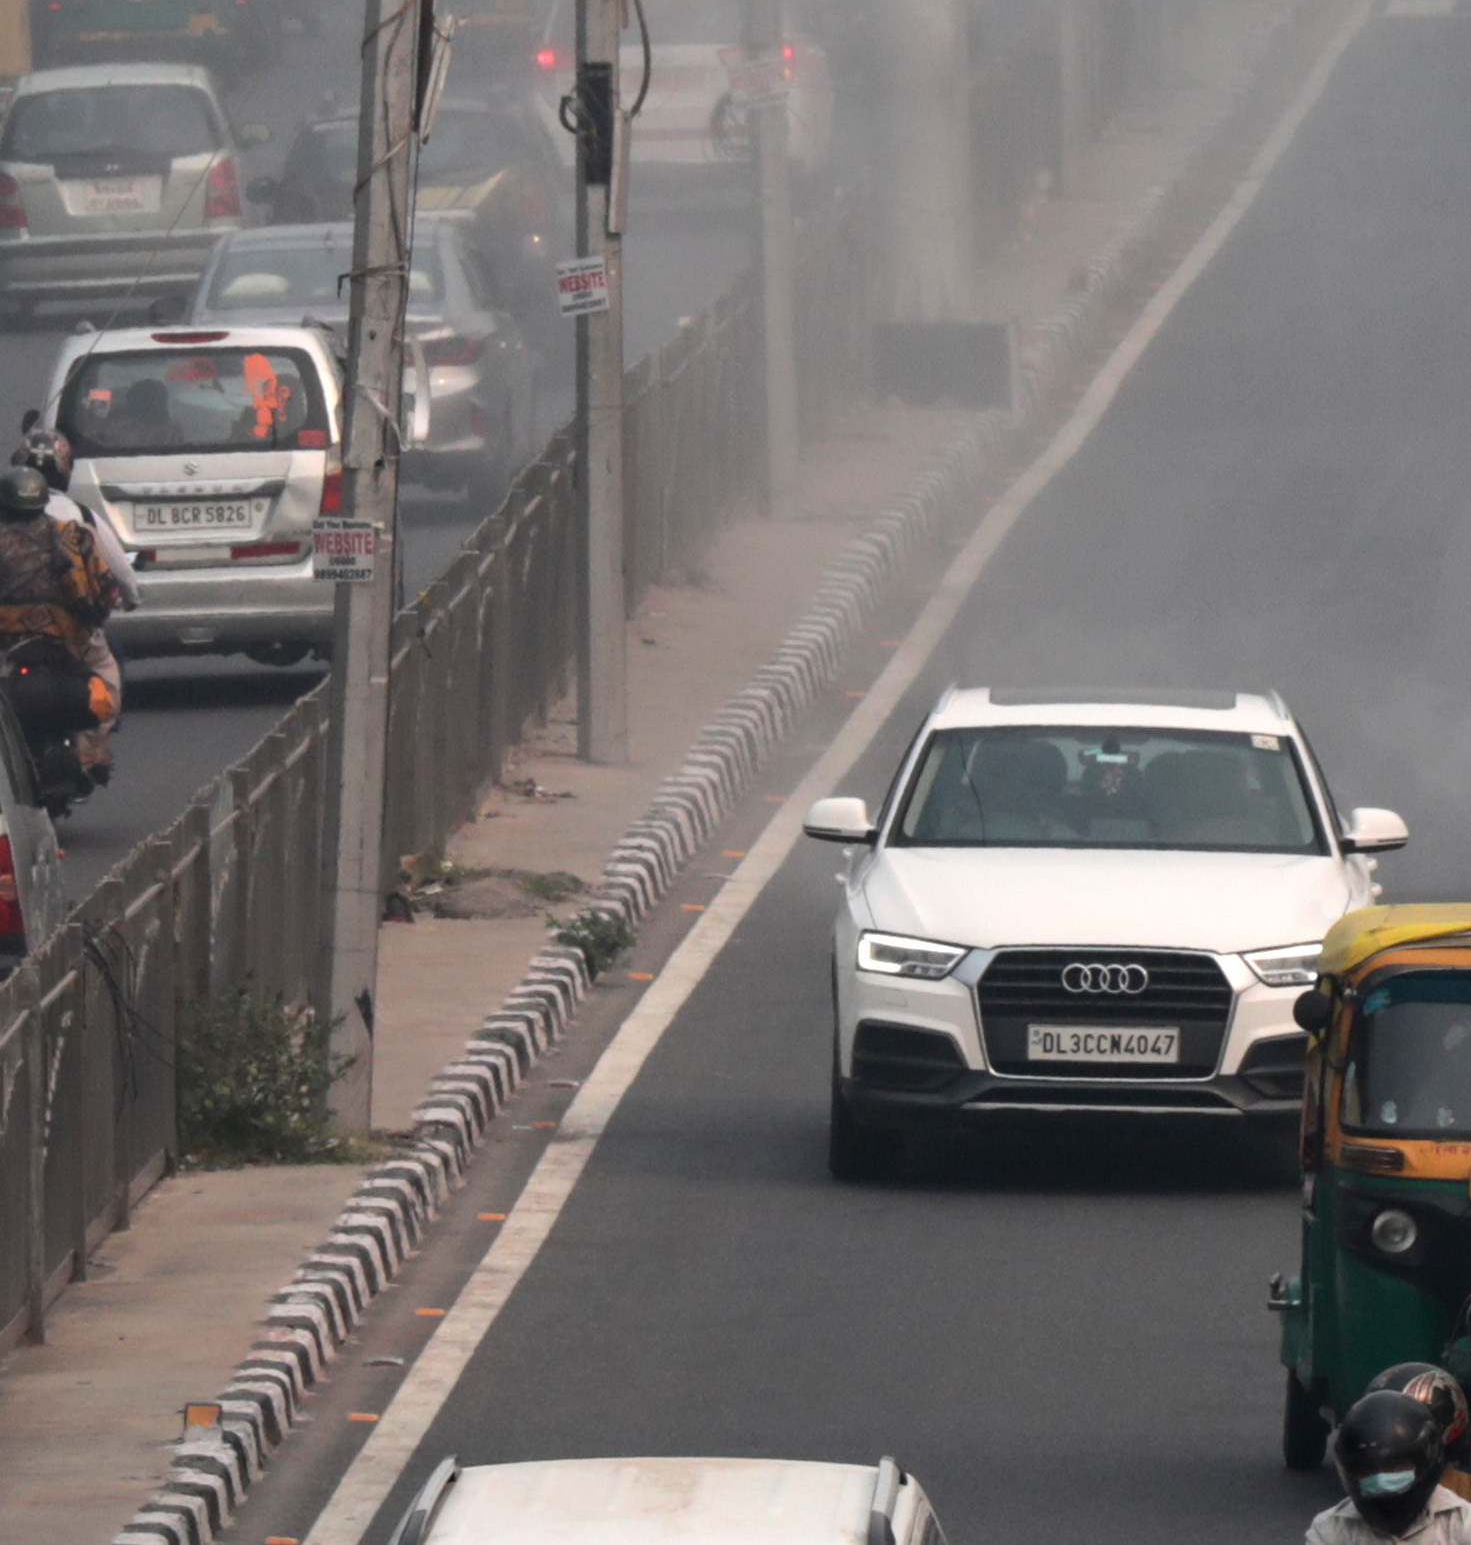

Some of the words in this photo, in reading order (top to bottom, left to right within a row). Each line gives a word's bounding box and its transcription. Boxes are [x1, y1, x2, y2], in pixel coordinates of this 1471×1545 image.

[205, 505, 246, 522] 5826
[313, 532, 373, 554] WEBSITE
[1043, 1032, 1175, 1055] DL3CCN4047
